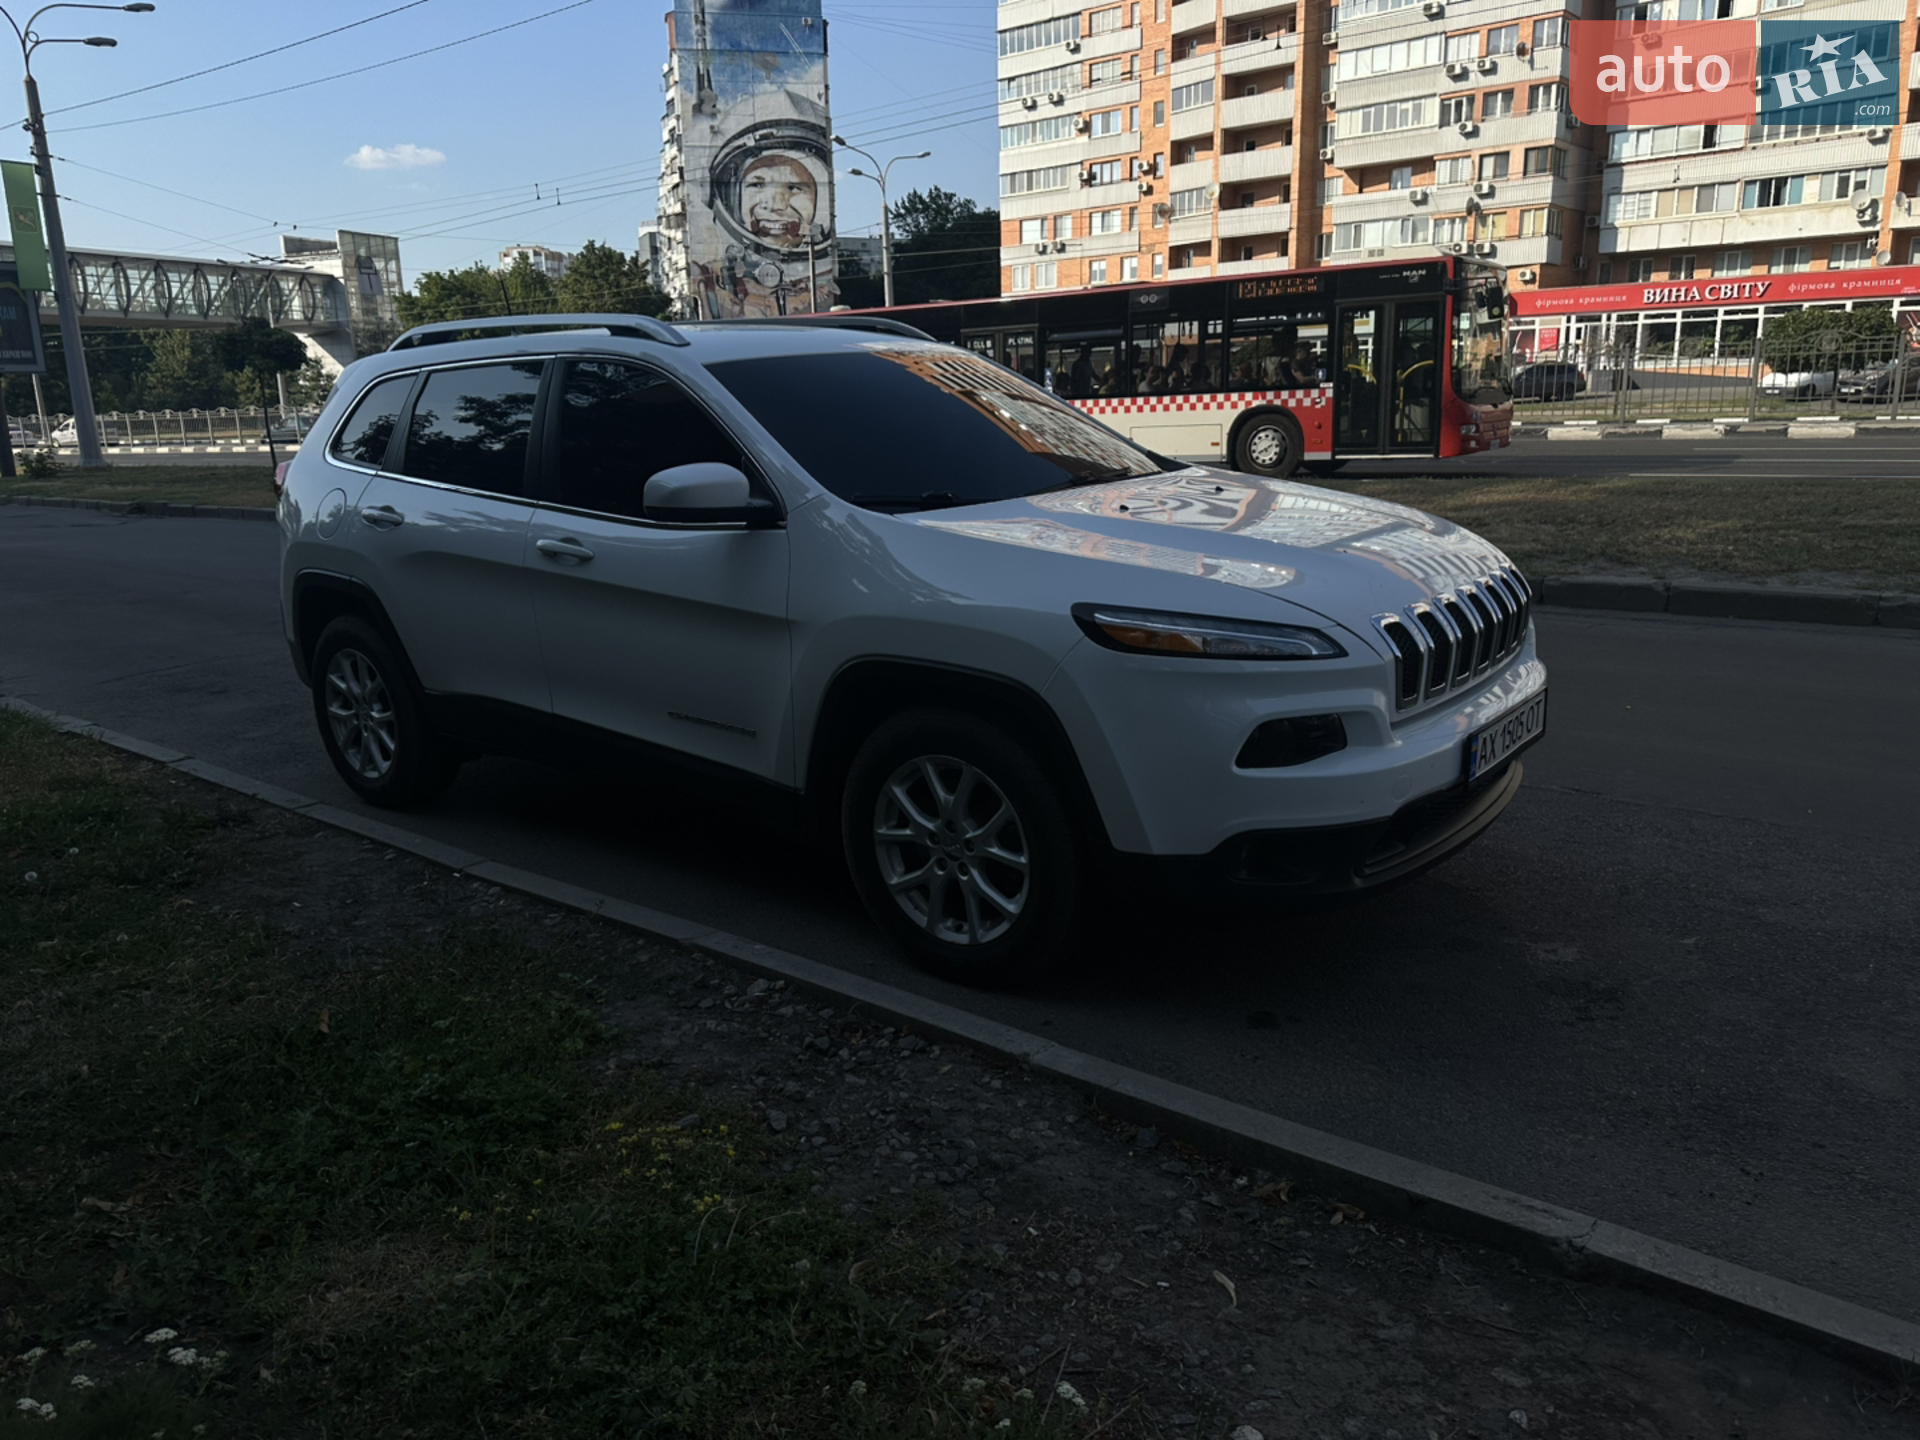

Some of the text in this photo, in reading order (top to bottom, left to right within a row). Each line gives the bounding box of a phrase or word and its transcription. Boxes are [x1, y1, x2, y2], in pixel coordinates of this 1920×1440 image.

[1402, 268, 1427, 277] MAN
[1643, 281, 1772, 304] ВИНА СВІТУ
[1788, 282, 1836, 294] фірмова
[1842, 278, 1902, 290] крамниця
[1535, 295, 1627, 309] фірмова крамниця
[1478, 697, 1542, 769] AX 1505 OT
